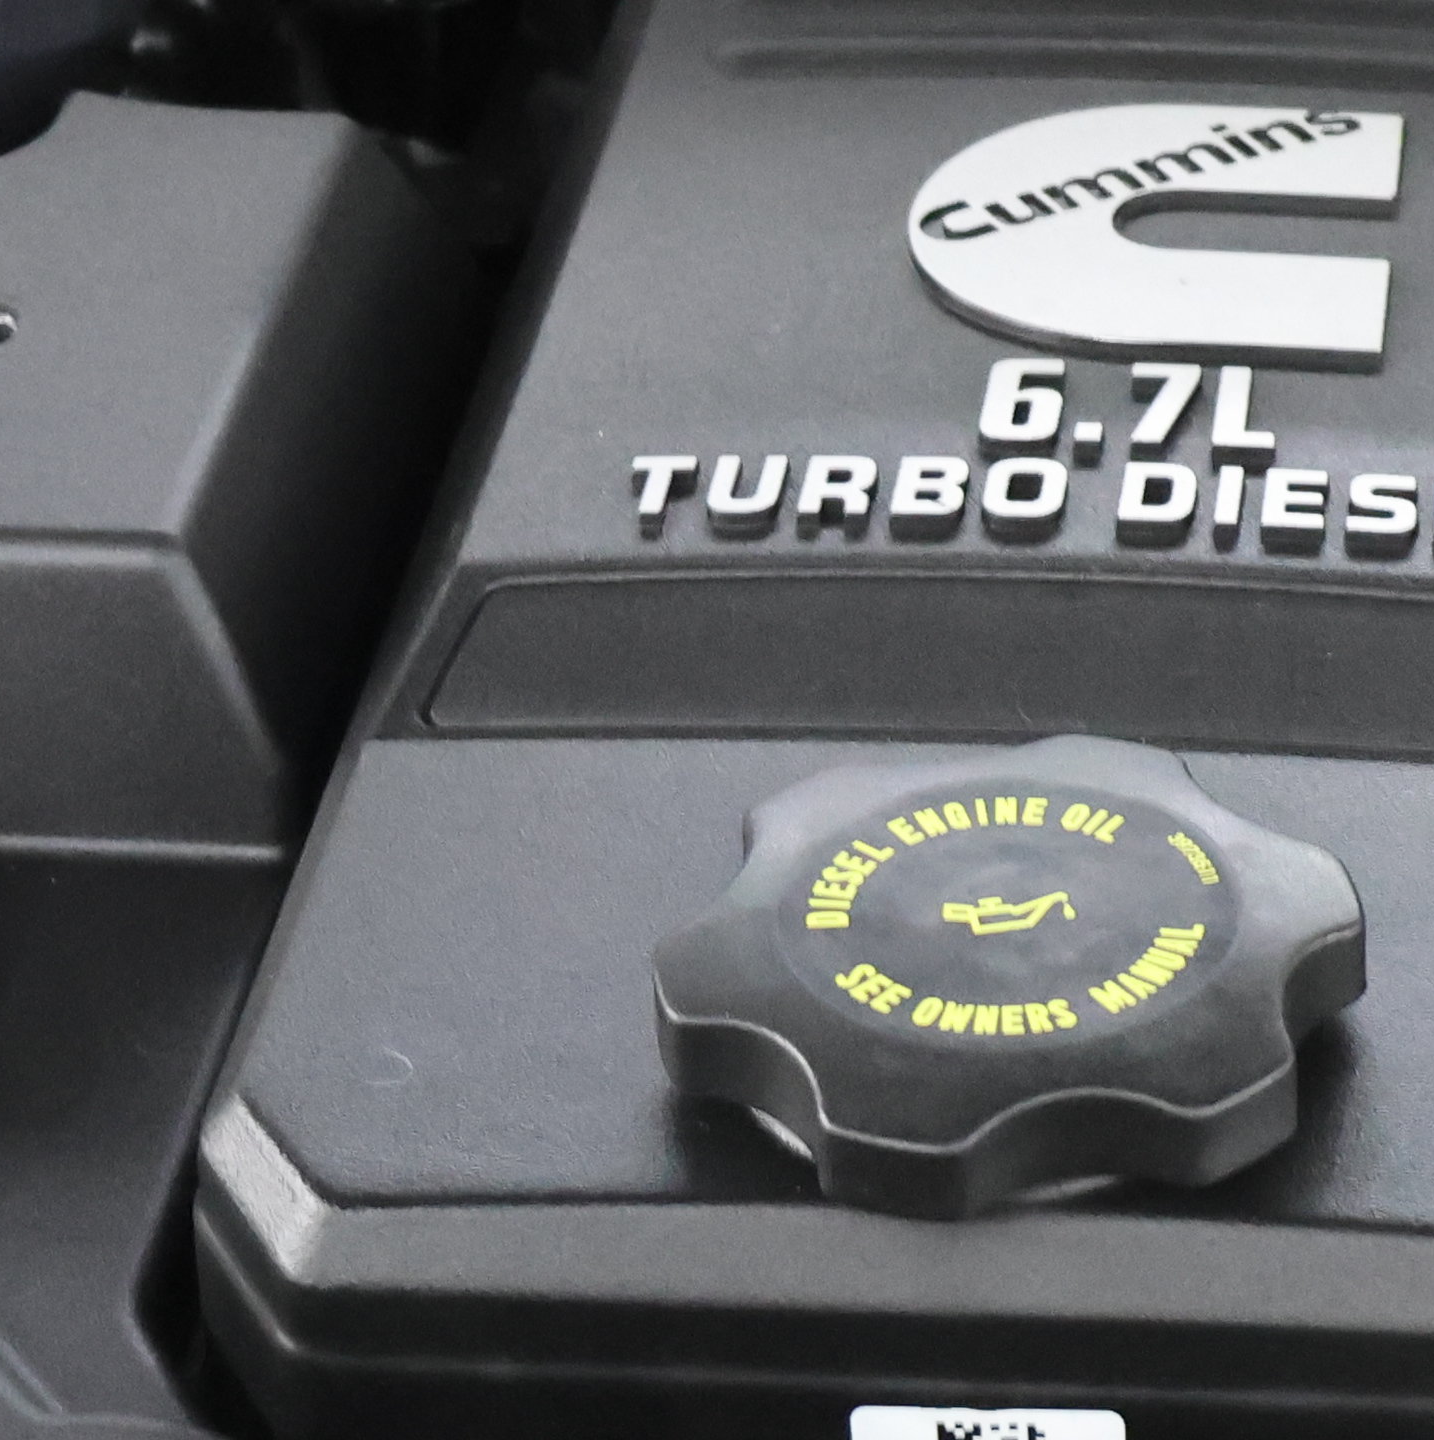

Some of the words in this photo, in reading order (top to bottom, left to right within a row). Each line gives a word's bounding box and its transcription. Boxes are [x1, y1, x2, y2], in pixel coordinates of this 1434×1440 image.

[918, 105, 1363, 242] Cummins
[977, 357, 1278, 456] 6.7L
[630, 453, 1068, 534] TURBO
[805, 839, 896, 929] DIESEL
[887, 797, 1049, 846] ENGINE
[1060, 803, 1125, 843] OIL
[834, 963, 913, 1015] SEE
[910, 996, 1079, 1036] OWNERS
[1088, 923, 1206, 1014] MANUAL
